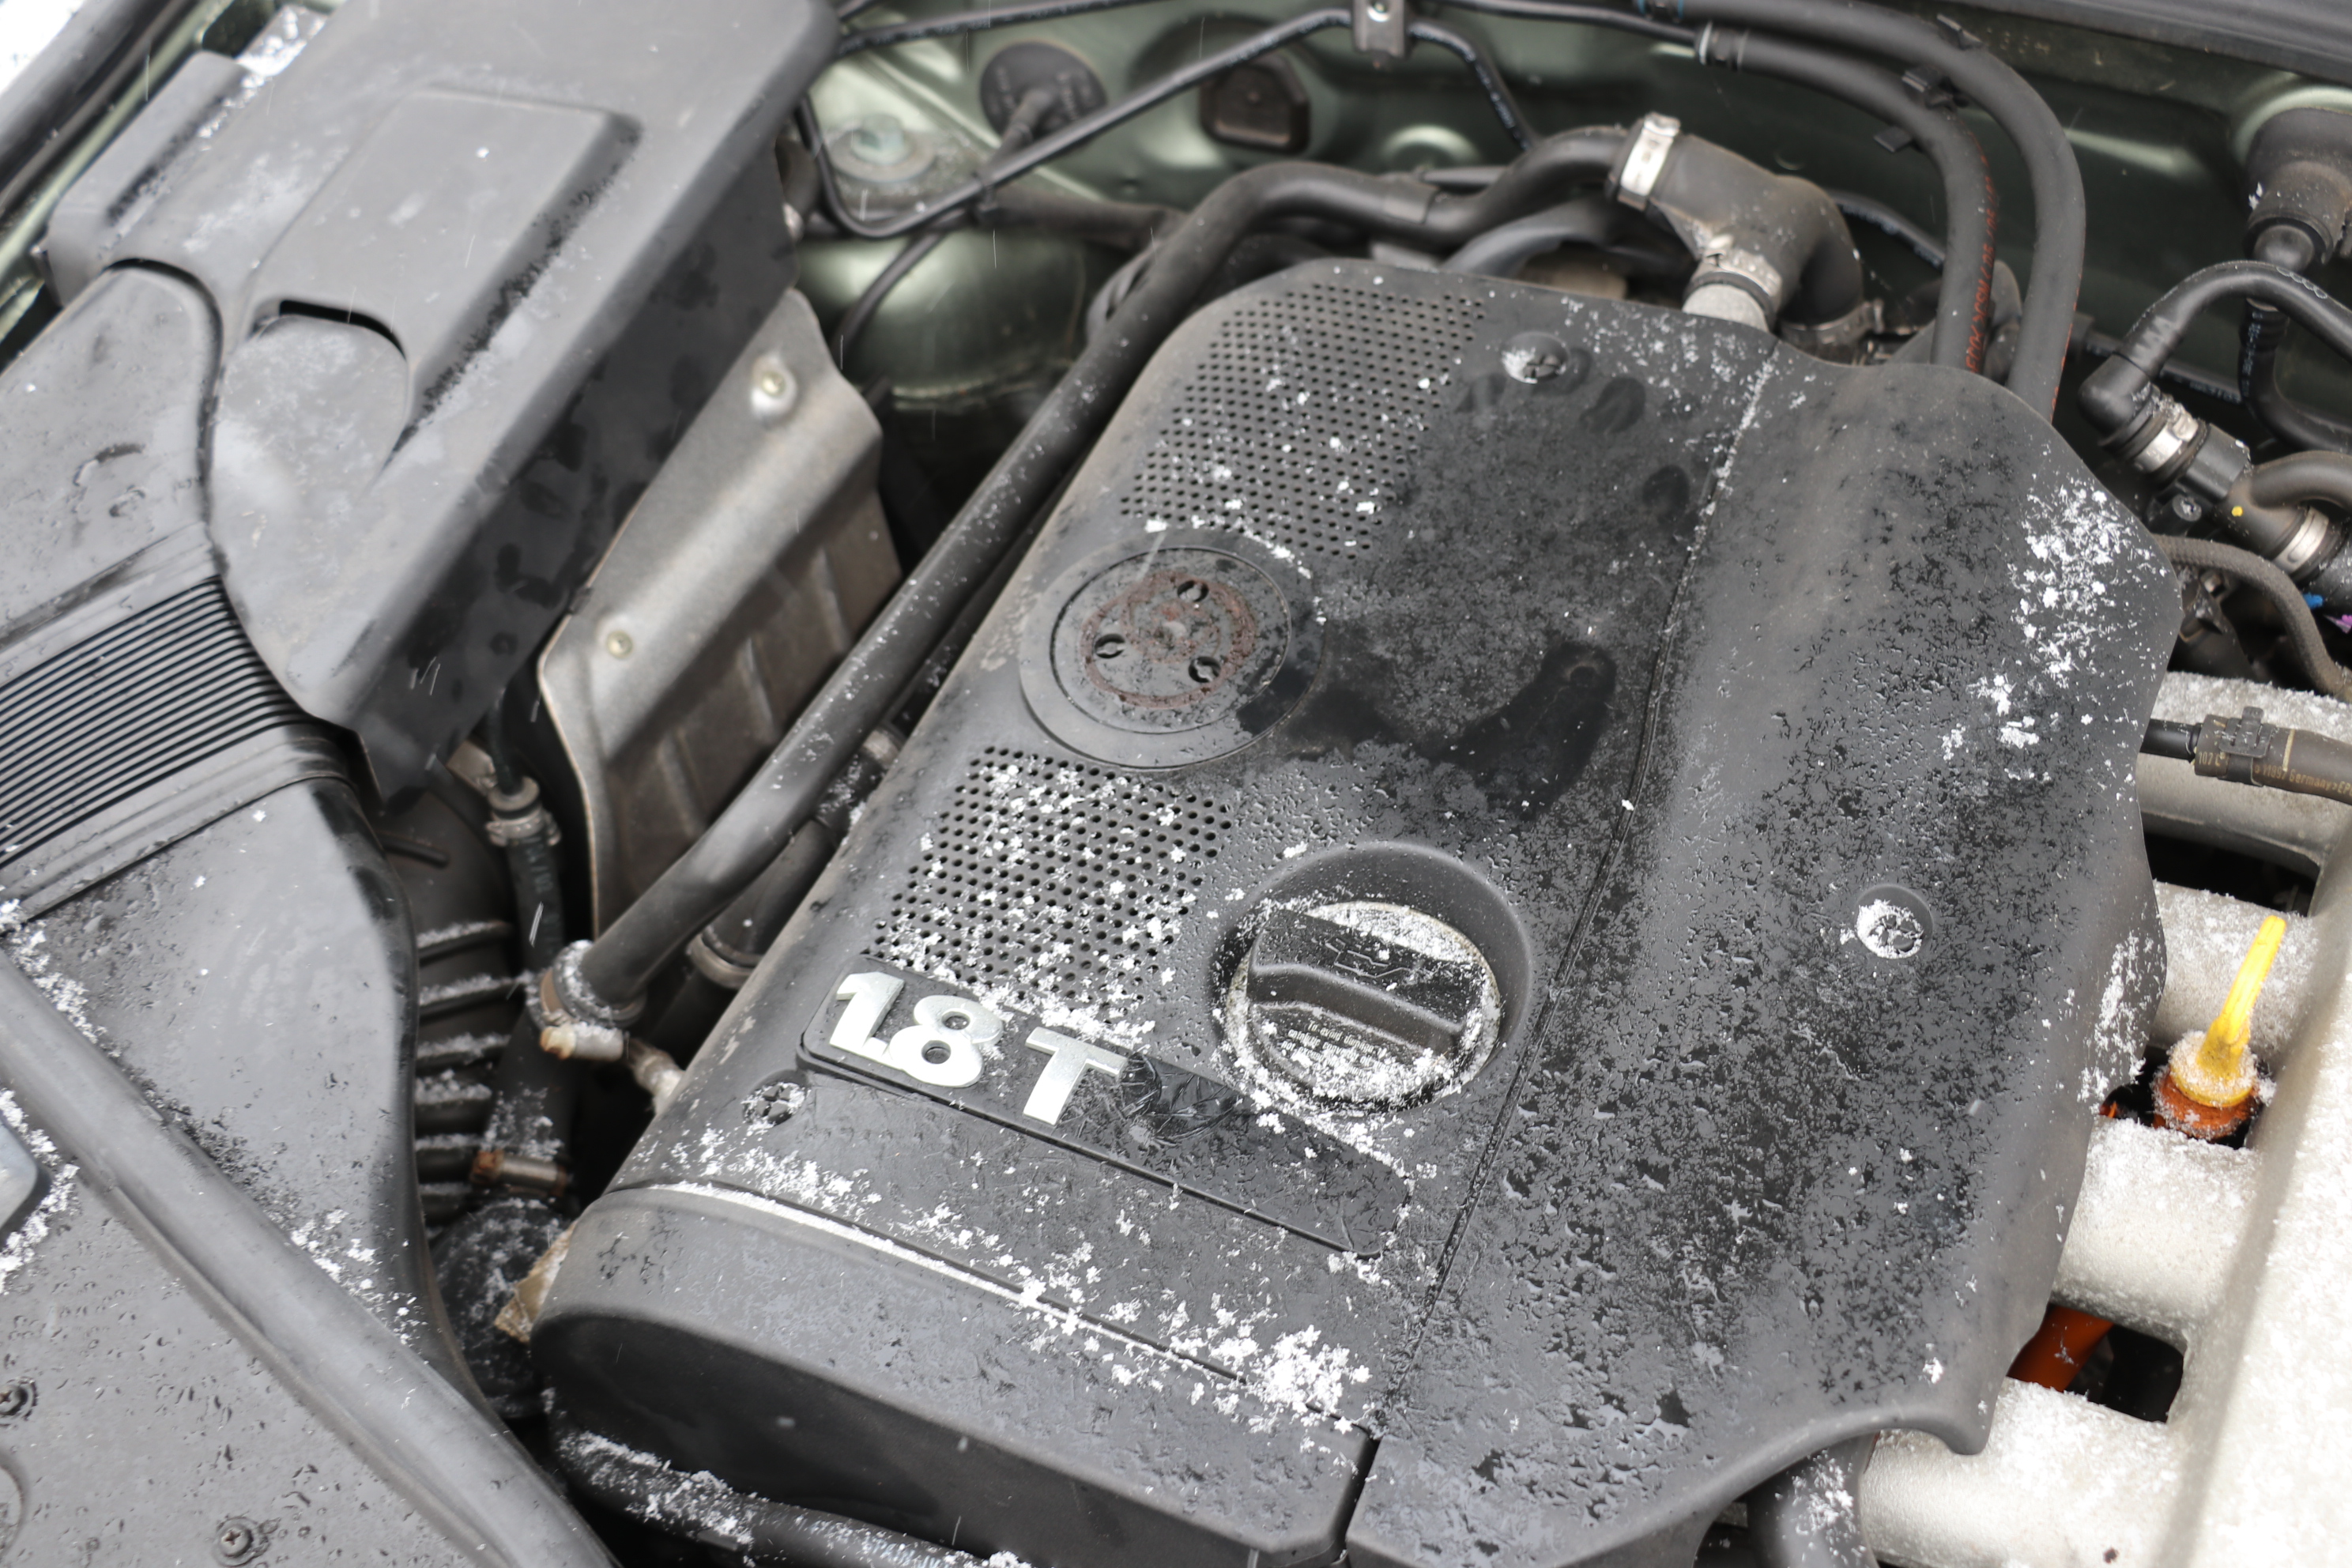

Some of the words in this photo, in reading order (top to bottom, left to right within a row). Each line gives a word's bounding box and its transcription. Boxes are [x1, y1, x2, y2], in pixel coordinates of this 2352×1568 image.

[1307, 1020, 1318, 1032] To
[1319, 1027, 1343, 1042] avoid
[1281, 1040, 1296, 1052] not
[1023, 1026, 1128, 1125] T
